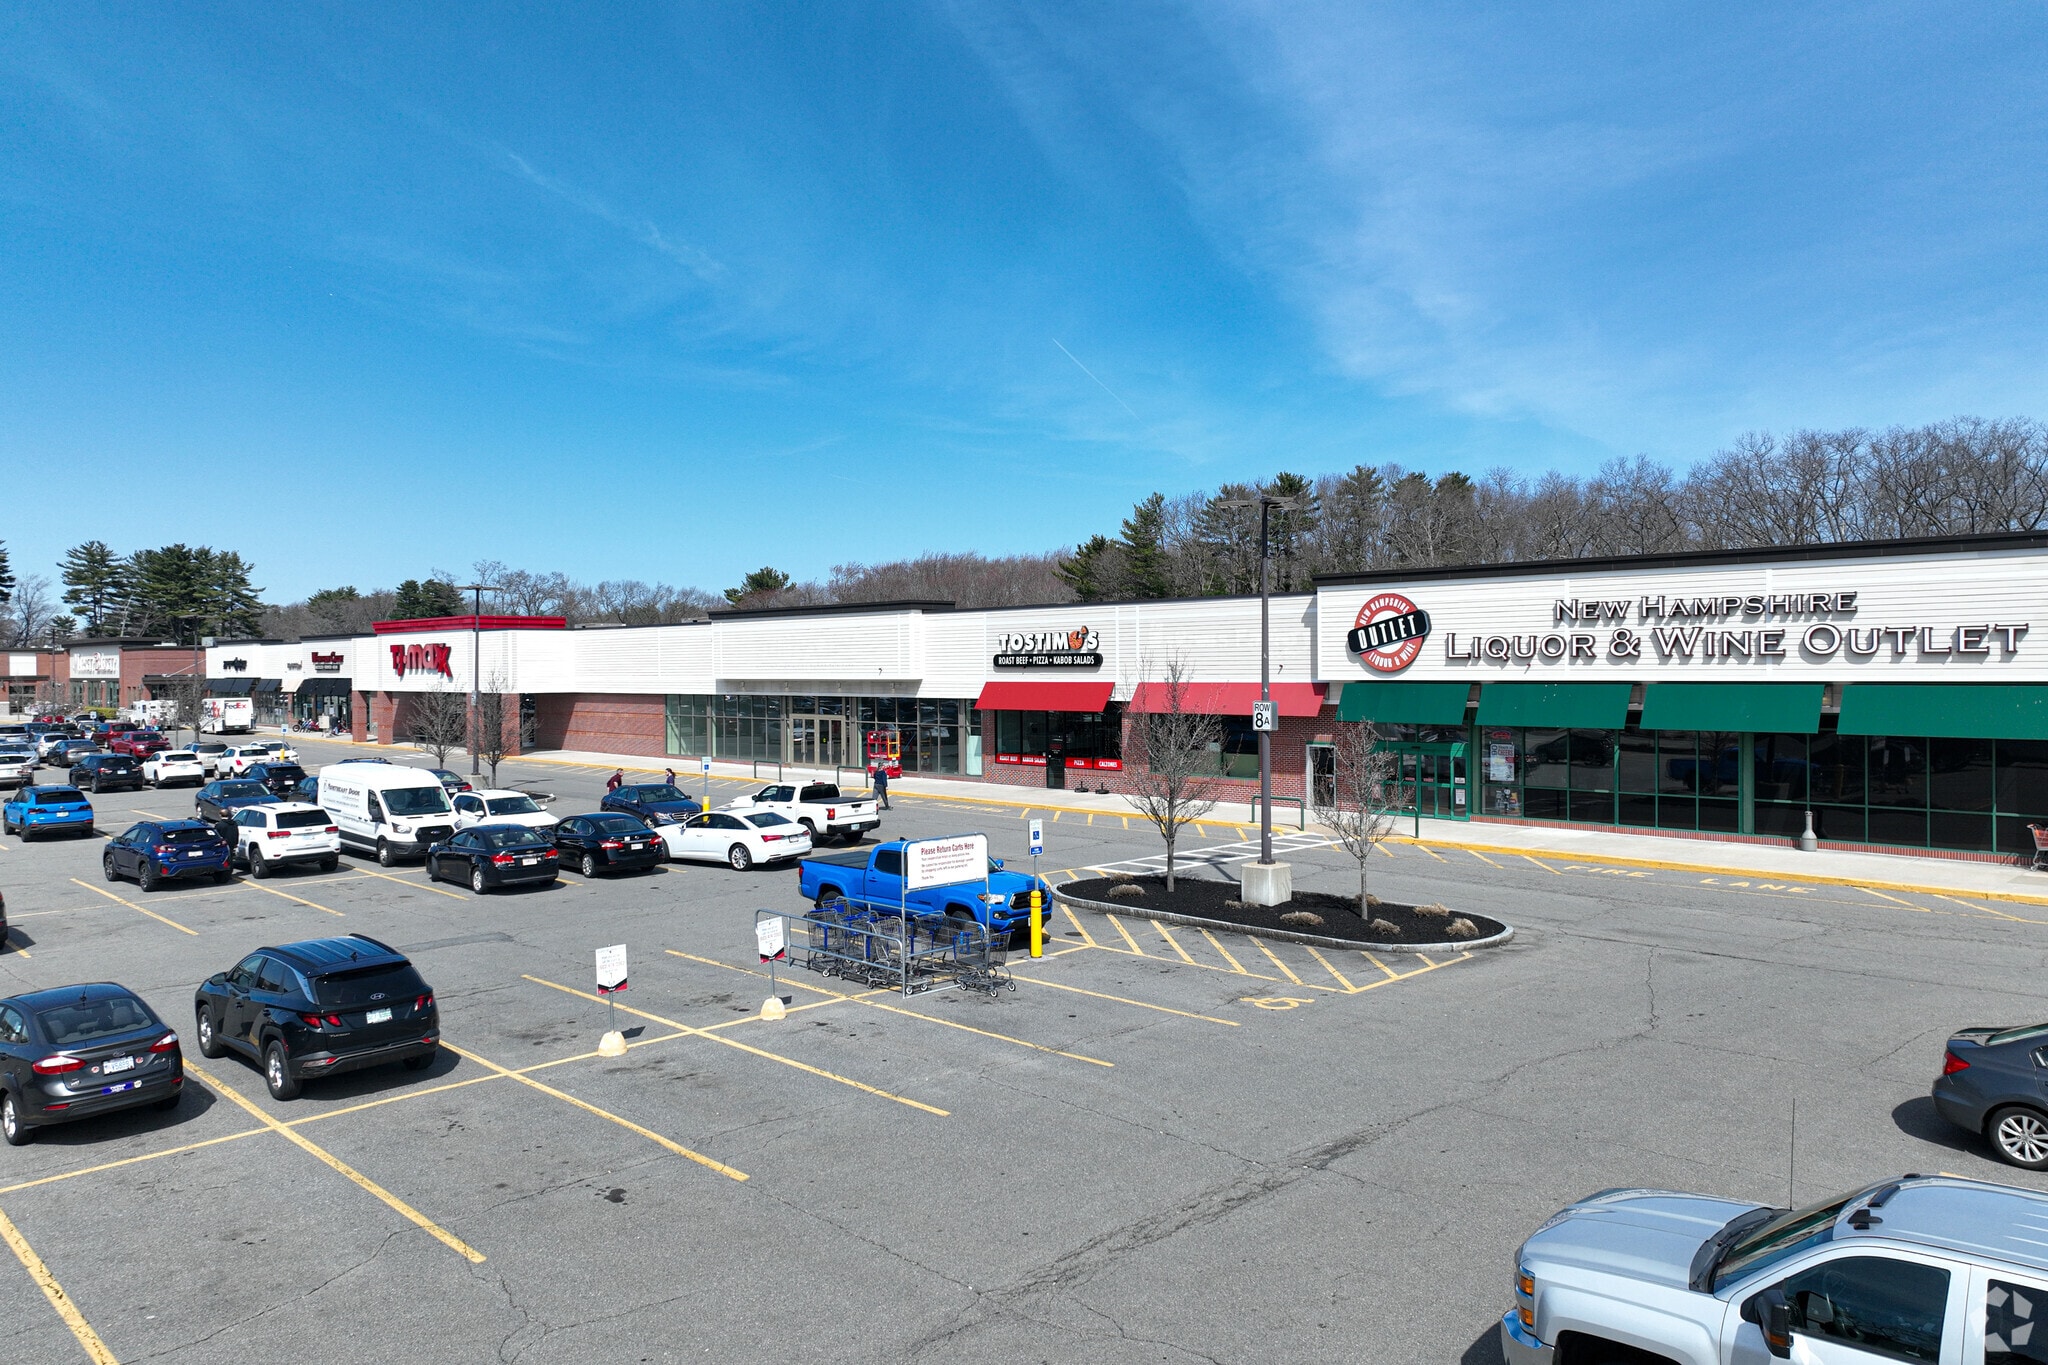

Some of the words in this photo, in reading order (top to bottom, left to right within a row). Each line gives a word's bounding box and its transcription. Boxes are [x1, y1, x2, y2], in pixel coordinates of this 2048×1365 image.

[1359, 608, 1372, 625] NEW
[1370, 597, 1410, 614] HAMPSHIRE
[1555, 599, 1631, 620] NEW
[1641, 591, 1857, 617] HAMPSHIRE
[1357, 614, 1416, 649] OUTLET
[1446, 633, 1597, 661] LIQUOR
[1610, 628, 1641, 657] &
[1653, 626, 1786, 657] WINE
[1803, 622, 2029, 655] OUTLET
[998, 656, 1015, 665] ROAST
[1015, 656, 1029, 665] BEEF
[1033, 656, 1049, 665] PIZZA
[1053, 655, 1073, 665] KABOB
[1073, 655, 1095, 665] SALADS
[1368, 652, 1393, 668] LIQUOR
[1399, 642, 1416, 662] WINE
[224, 702, 247, 710] FedEx
[1254, 703, 1271, 712] ROW
[920, 847, 936, 856] Please
[936, 845, 951, 854] Return
[951, 843, 964, 852] Carts
[964, 842, 975, 850] Here
[1564, 865, 1655, 878] FIRE
[1699, 878, 1818, 894] LANE
